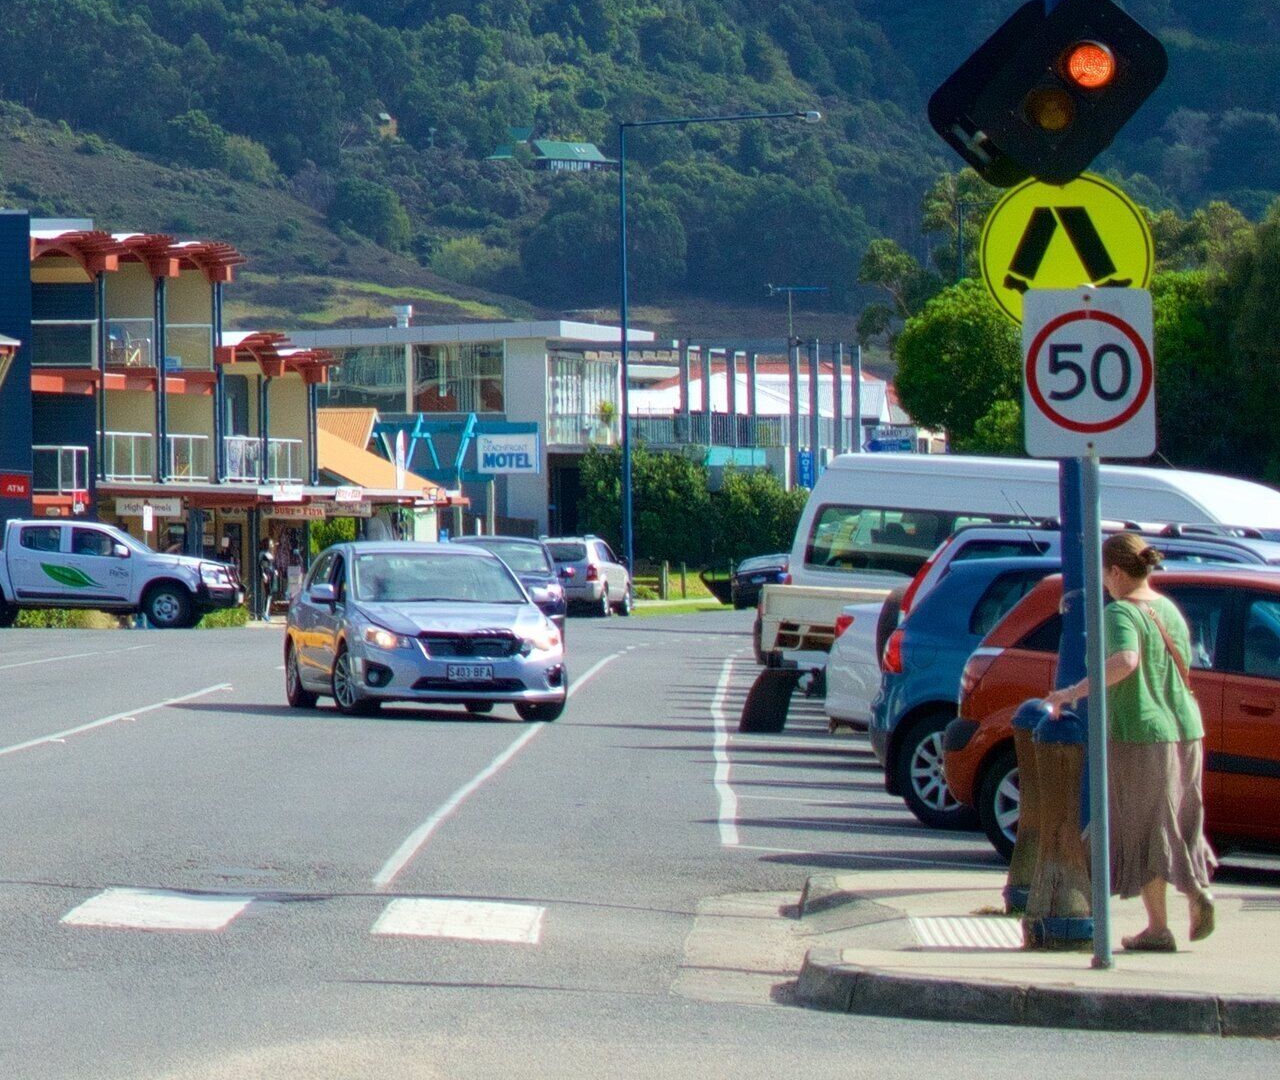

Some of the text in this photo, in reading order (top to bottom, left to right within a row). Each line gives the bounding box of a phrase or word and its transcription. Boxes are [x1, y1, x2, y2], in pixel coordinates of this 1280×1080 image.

[1048, 343, 1131, 401] 50
[482, 453, 533, 468] MOTEL
[6, 484, 25, 493] ATM
